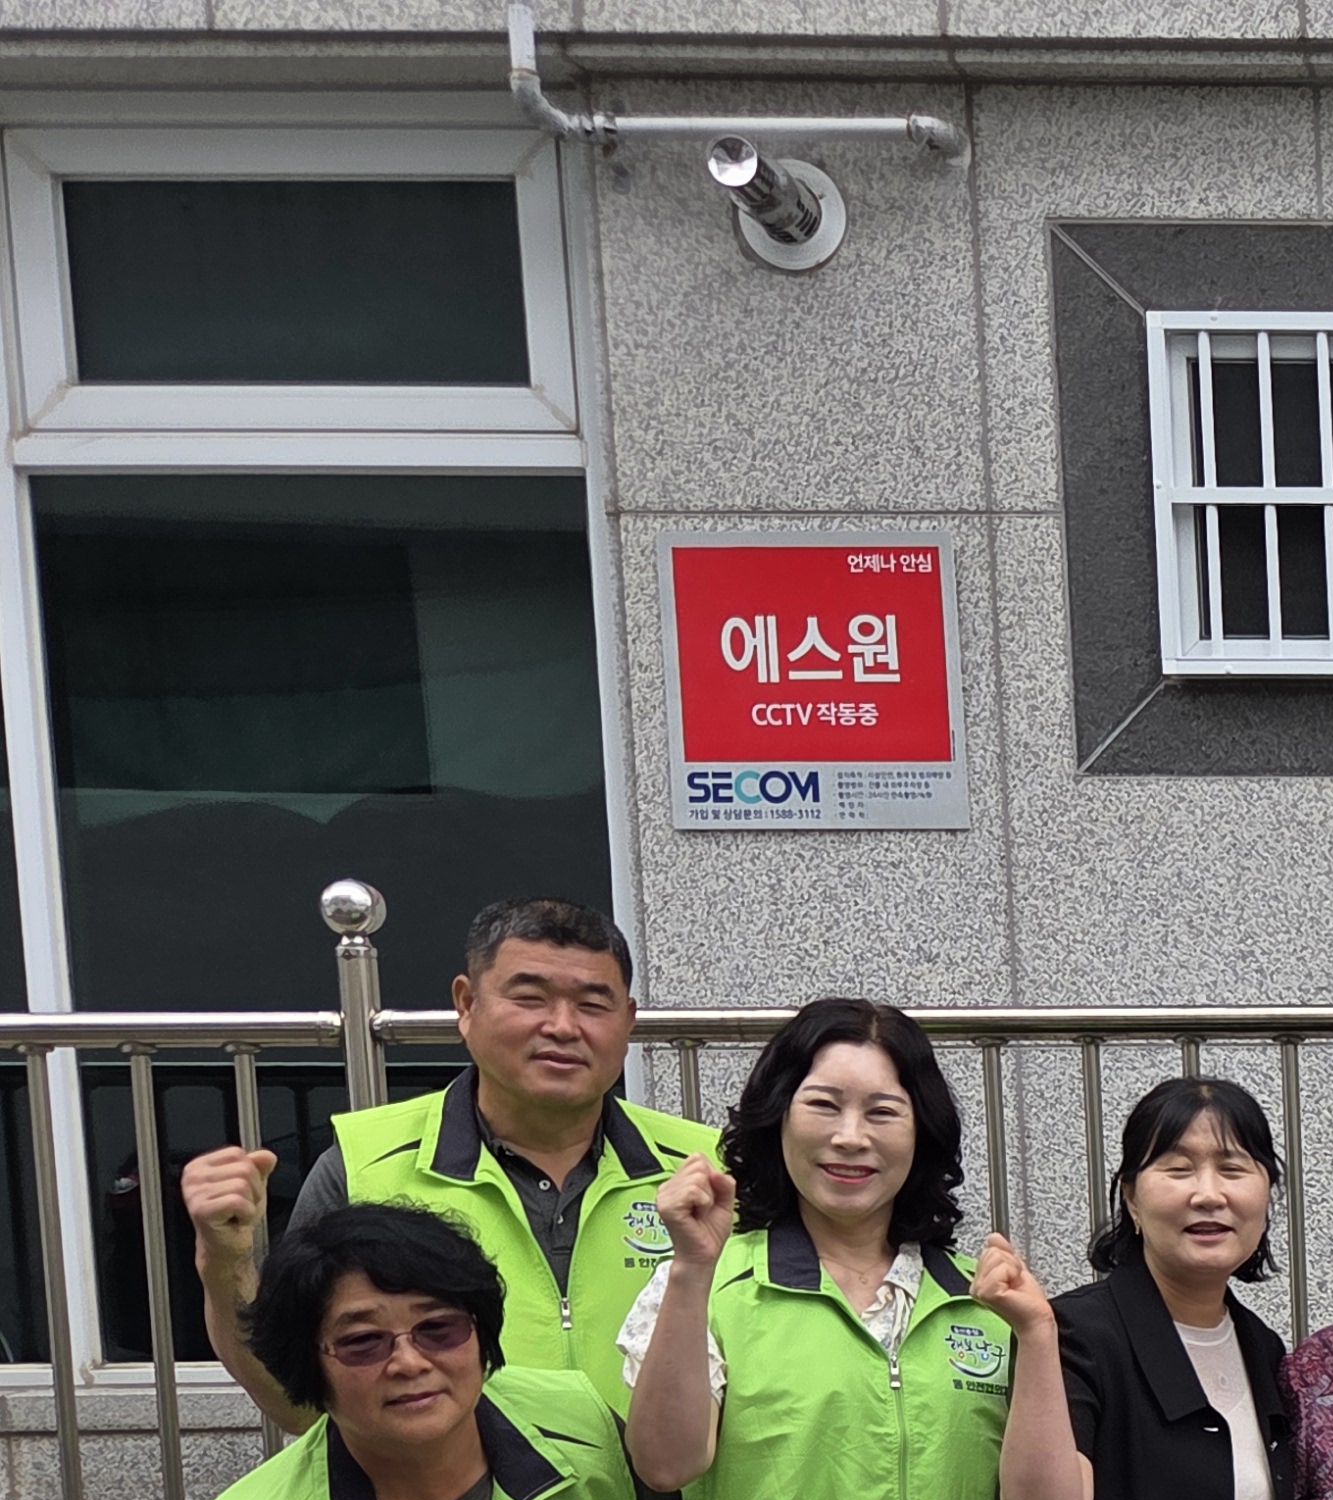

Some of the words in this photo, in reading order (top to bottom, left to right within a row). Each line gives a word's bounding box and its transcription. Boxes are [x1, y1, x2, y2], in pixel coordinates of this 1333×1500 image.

[847, 553, 896, 573] 언제나
[899, 553, 933, 573] 안심
[721, 614, 901, 684] 에스원
[751, 703, 813, 726] CCTV
[816, 702, 880, 726] 작동중
[687, 770, 821, 804] SECOM
